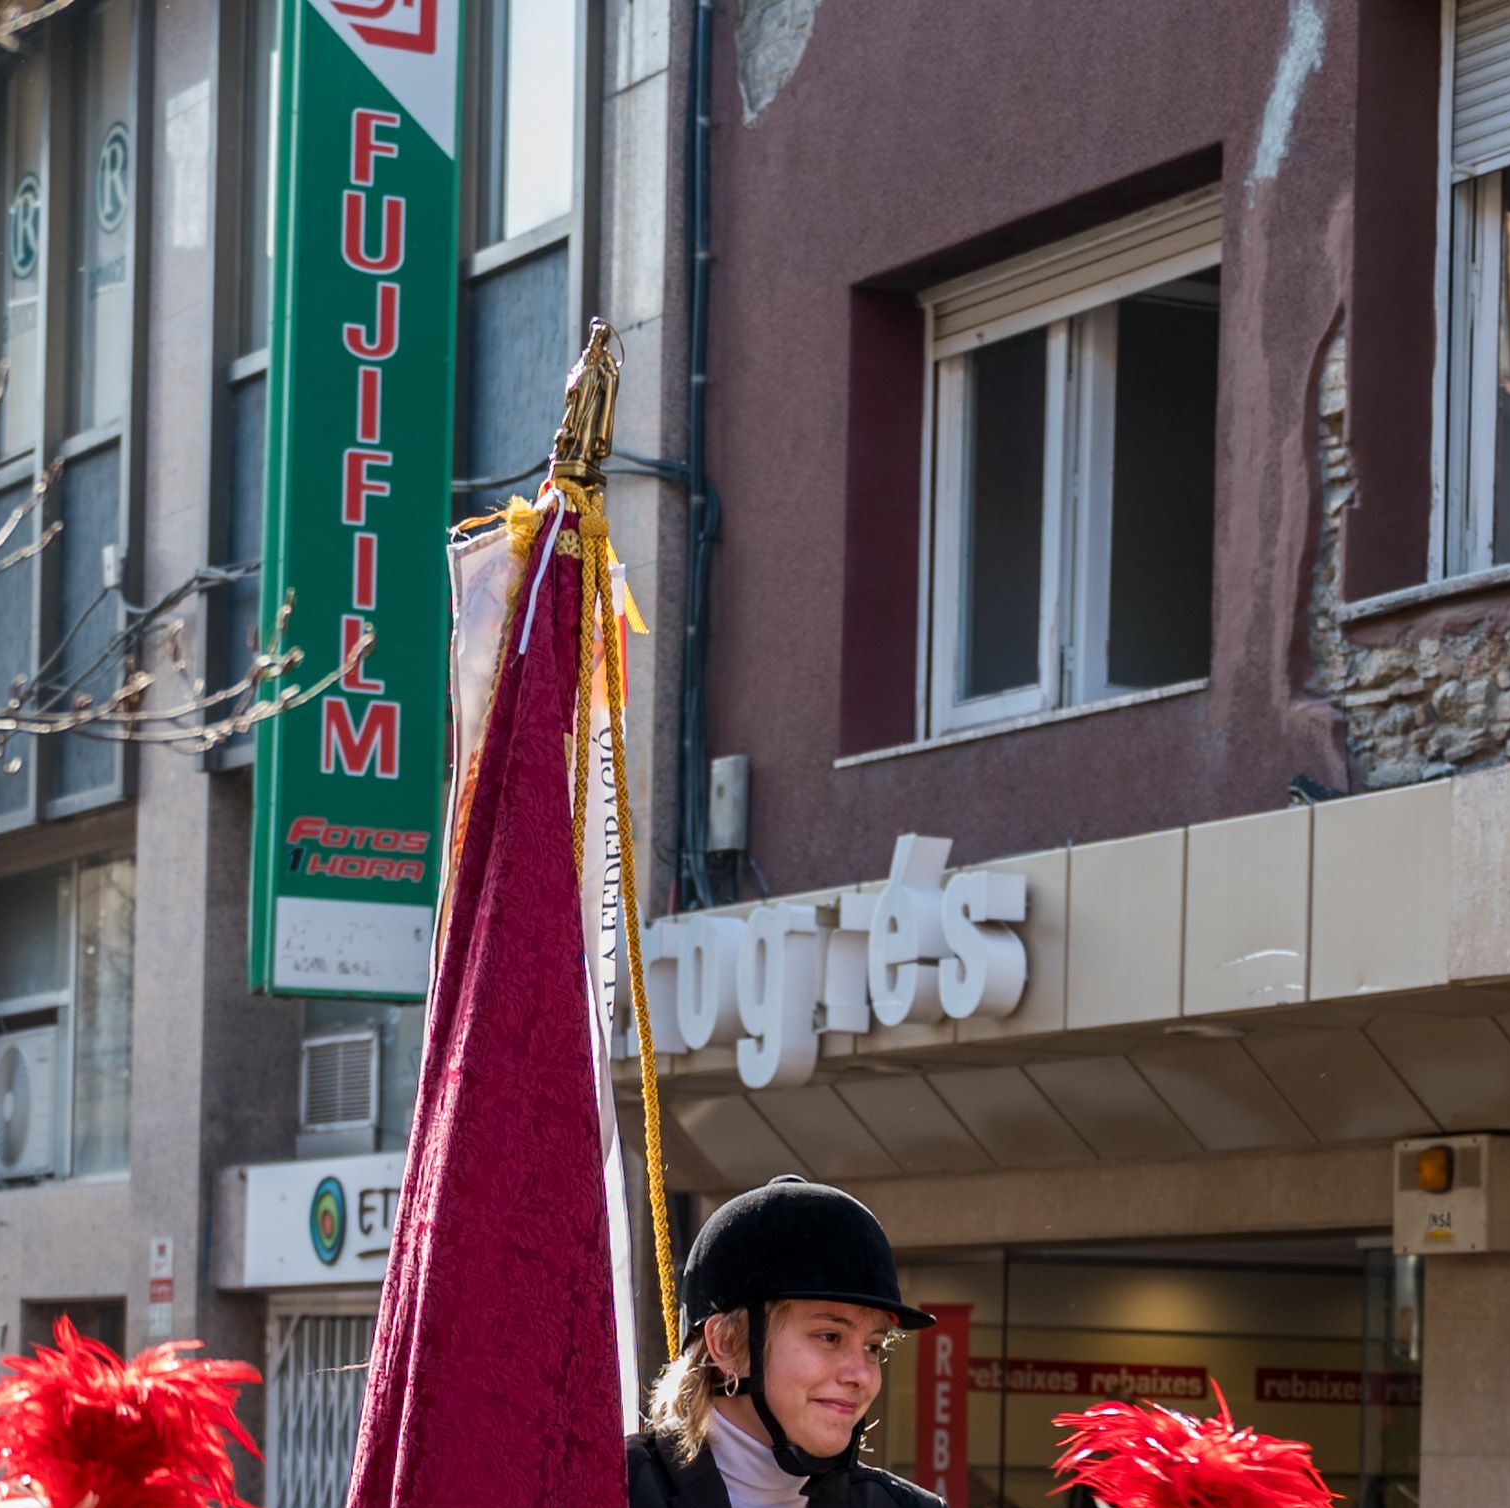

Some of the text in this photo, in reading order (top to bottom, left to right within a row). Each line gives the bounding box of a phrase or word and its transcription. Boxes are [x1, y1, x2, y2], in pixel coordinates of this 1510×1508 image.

[320, 107, 405, 779] FUJIFILM
[289, 847, 425, 882] 1 HORA
[1091, 1367, 1203, 1396] rebaixes
[1264, 1370, 1371, 1400] rebaixes
